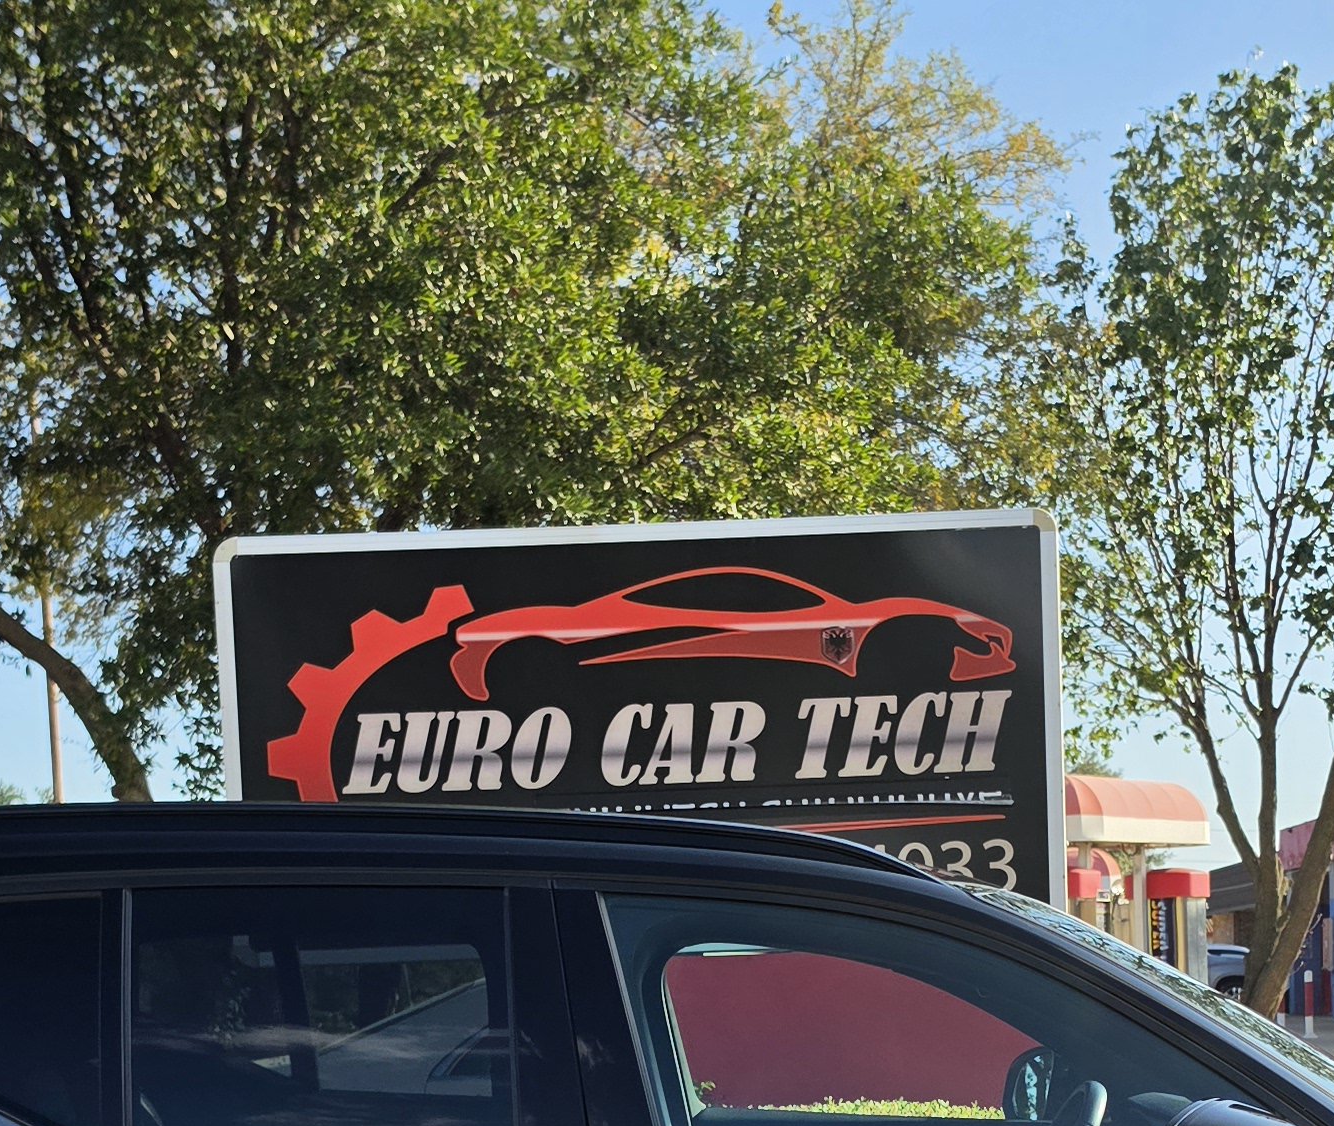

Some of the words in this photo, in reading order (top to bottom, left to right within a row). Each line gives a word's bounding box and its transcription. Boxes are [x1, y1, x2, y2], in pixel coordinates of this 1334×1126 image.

[342, 706, 572, 794] EURO
[600, 700, 765, 787] CAR
[795, 690, 1013, 781] TECH
